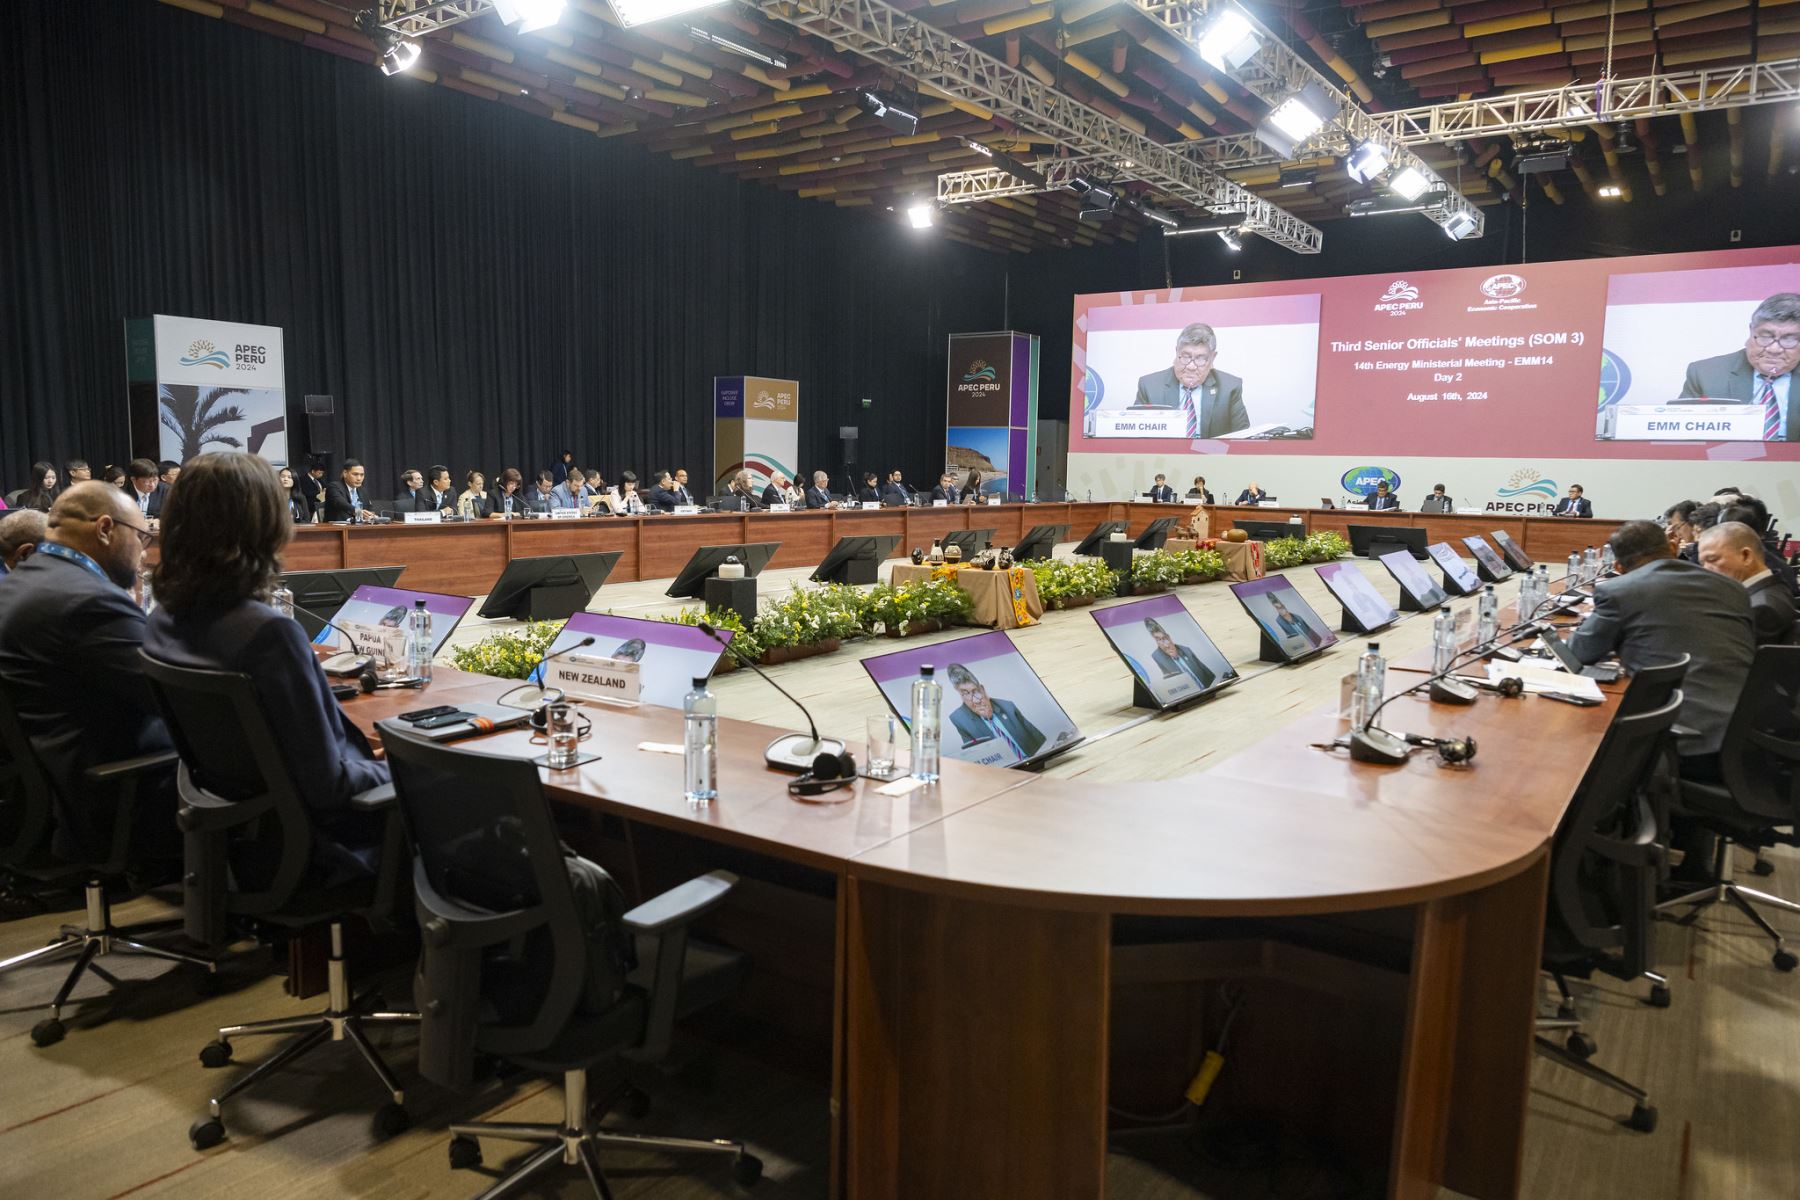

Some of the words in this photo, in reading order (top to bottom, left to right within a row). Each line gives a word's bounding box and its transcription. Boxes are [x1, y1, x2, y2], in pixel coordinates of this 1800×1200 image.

[1331, 341, 1361, 352] Third
[1364, 340, 1404, 351] Senior
[1465, 336, 1525, 348] Meetings
[1528, 333, 1567, 348] (SOM
[1571, 332, 1584, 346] 3)
[235, 344, 266, 354] APEC
[236, 354, 266, 364] PERU
[1354, 362, 1374, 370] 14th
[1376, 362, 1409, 370] Energy
[1412, 359, 1462, 368] Ministerial
[1464, 358, 1505, 368] Meeting
[1514, 356, 1552, 366] EMM14
[1434, 373, 1454, 383] Day
[1456, 373, 1462, 382] 2
[1407, 393, 1438, 402] August
[1466, 392, 1488, 400] 2024
[1648, 422, 1680, 430] EMM
[1685, 422, 1732, 430] CHAIR
[1486, 502, 1524, 512] APEC
[360, 632, 381, 643] PAPUA
[559, 670, 580, 682] NEW
[582, 674, 626, 688] ZEALAND
